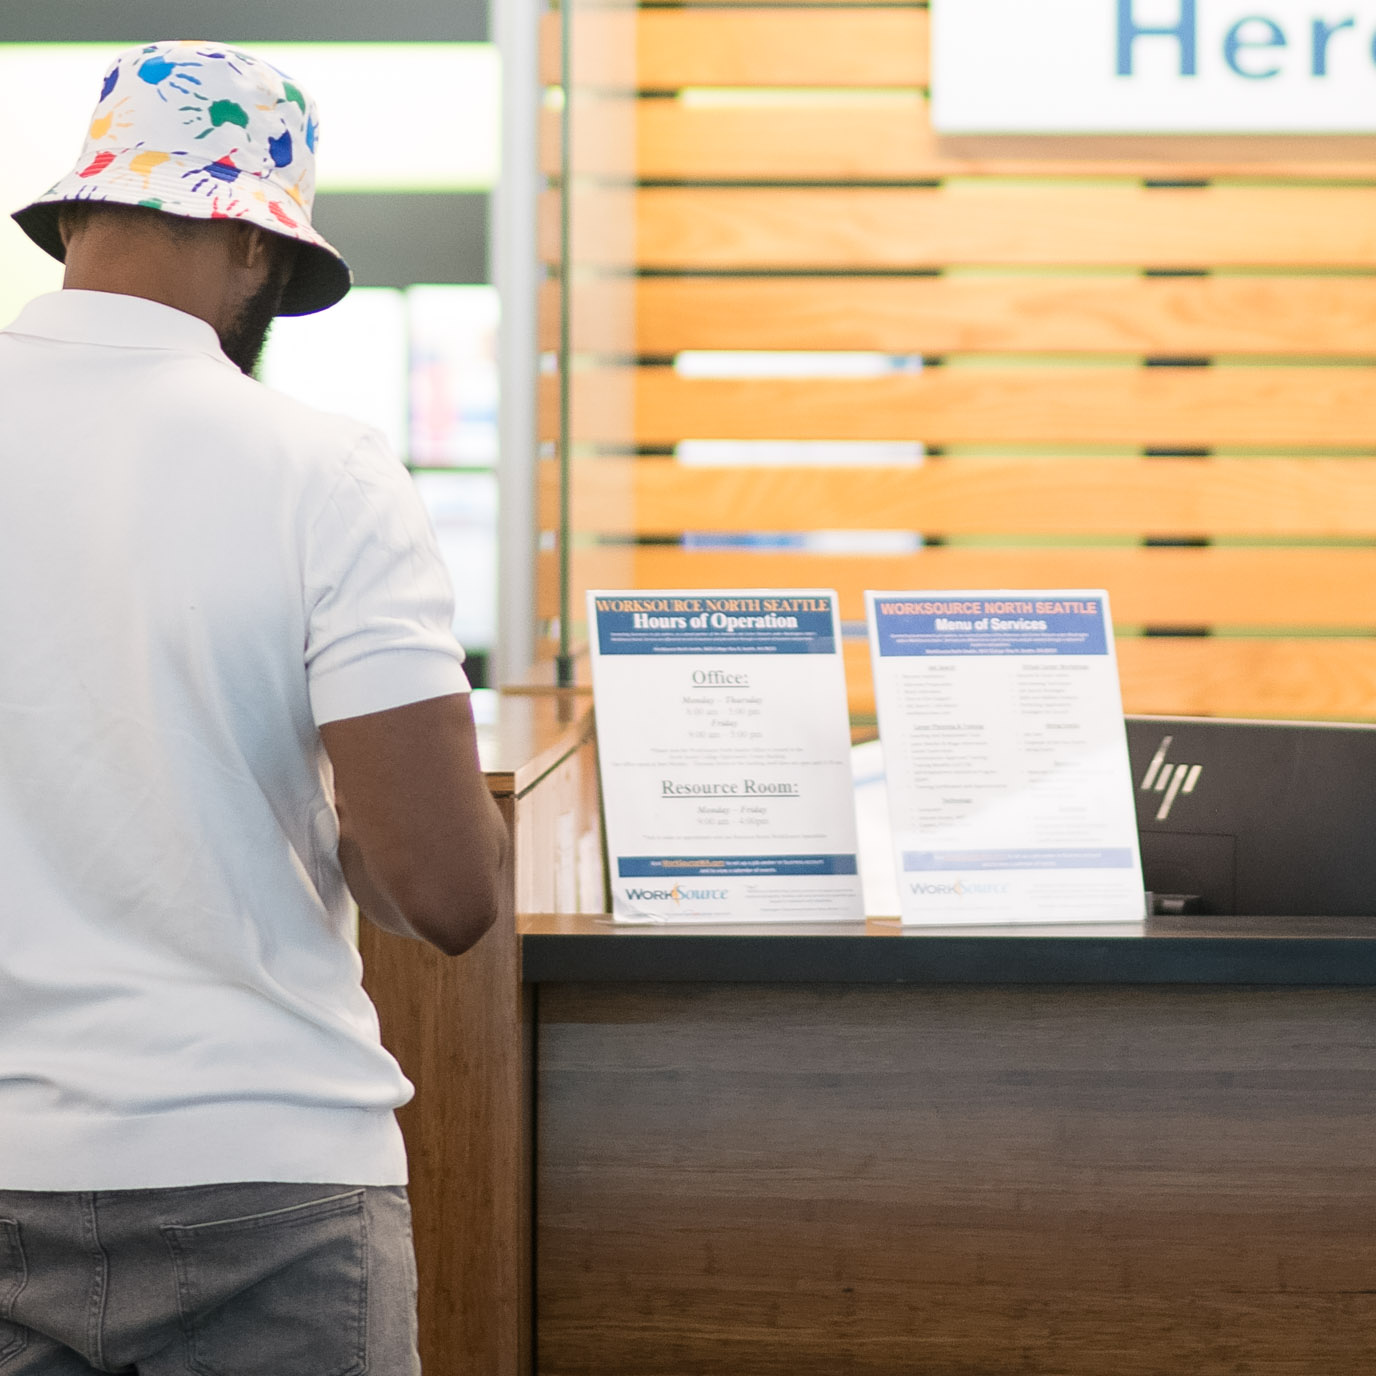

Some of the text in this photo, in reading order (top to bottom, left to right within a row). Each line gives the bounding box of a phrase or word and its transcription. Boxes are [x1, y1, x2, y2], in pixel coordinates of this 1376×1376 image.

[596, 599, 830, 612] WORKSOURCE NORTH SEATTLE
[880, 601, 1097, 616] WORKSOURCE NORTH SEATTLE
[633, 613, 798, 632] Hours of Operation
[935, 618, 1047, 631] Menu of Services
[692, 670, 750, 685] Office:
[1140, 735, 1203, 820] hp
[661, 778, 800, 795] Resource Room:
